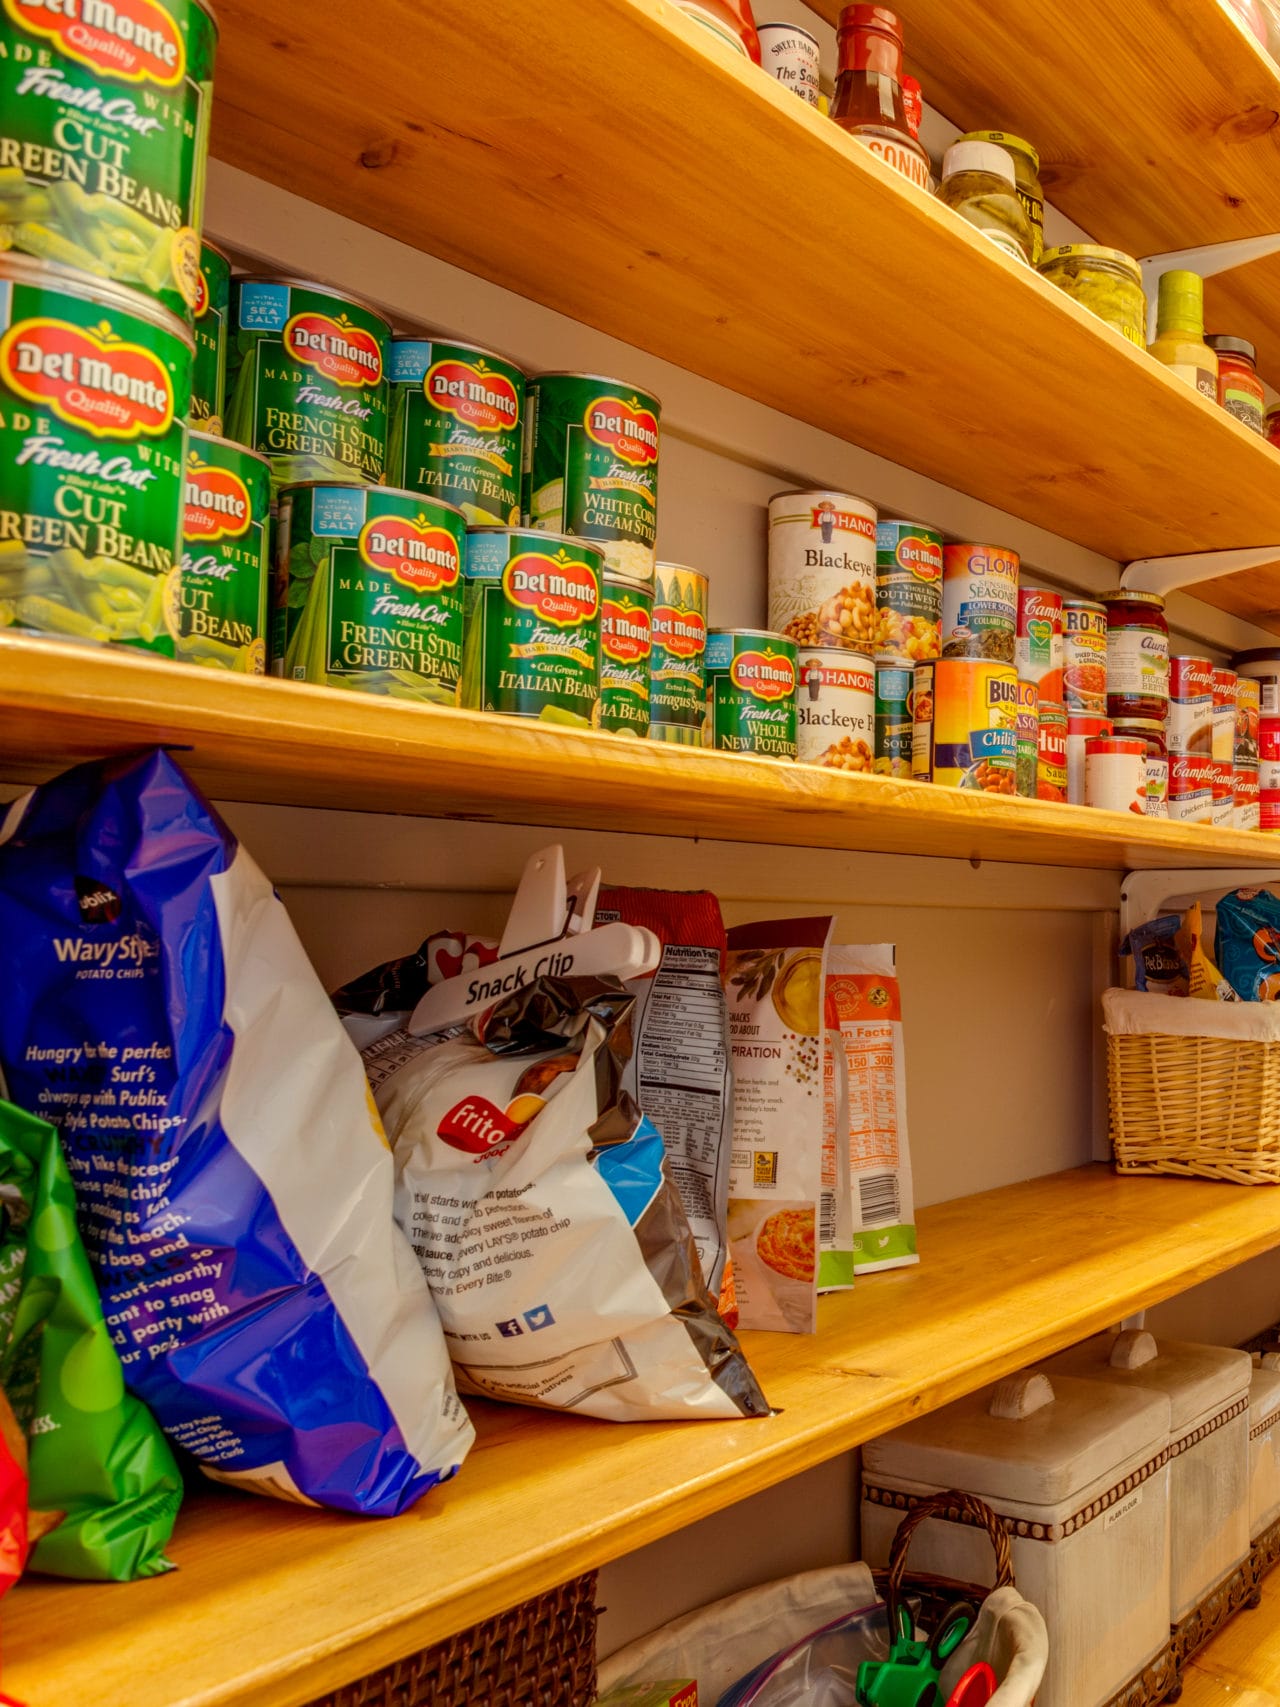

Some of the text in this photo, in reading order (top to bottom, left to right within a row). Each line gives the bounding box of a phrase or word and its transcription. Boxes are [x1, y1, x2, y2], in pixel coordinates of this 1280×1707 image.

[67, 25, 136, 68] Quality
[771, 40, 797, 56] SWEET
[776, 67, 797, 80] The
[53, 118, 130, 169] CUT
[97, 162, 182, 229] BEANS
[246, 315, 281, 324] SALT
[250, 306, 277, 315] SEA
[294, 328, 378, 372] Del Monte
[323, 357, 359, 377] Quality
[394, 368, 423, 376] SALT
[16, 343, 167, 412] Del Monte
[265, 369, 314, 385] MADE
[65, 389, 131, 423] Quality
[434, 376, 516, 417] Del Monte
[461, 402, 497, 422] Quality
[266, 408, 345, 441] FRENCH
[594, 412, 622, 433] Del
[269, 429, 382, 476] GREEN BEANS
[617, 439, 646, 457] Quality
[418, 467, 516, 507] ITALIAN BEANS
[54, 485, 127, 528] CUT
[583, 492, 632, 515] WHITE
[319, 521, 357, 530] SALT
[324, 512, 353, 521] SEA
[583, 508, 632, 532] CREAM
[99, 525, 172, 574] BEANS
[371, 533, 457, 571] Del Monte
[474, 555, 498, 563] SEA
[902, 547, 916, 560] Del
[400, 561, 438, 581] Quality
[471, 563, 501, 572] SALT
[805, 549, 871, 578] Blackeye
[968, 555, 1019, 583] GLORY
[339, 579, 391, 594] MADE
[513, 570, 596, 604] Del Monte
[542, 598, 577, 616] Quality
[969, 601, 997, 611] LOWER
[190, 612, 252, 645] BEANS
[974, 617, 1000, 627] COLLARD
[1067, 612, 1089, 630] RO
[340, 621, 423, 652] FRENCH
[343, 643, 459, 682] GREEN BEANS
[738, 664, 792, 684] Del Monte
[498, 671, 597, 700] ITALIAN BEANS
[719, 696, 751, 705] MADE
[747, 720, 787, 739] WHOLE
[722, 735, 752, 750] NEW
[983, 732, 1011, 748] Chili
[1181, 804, 1204, 818] Chicken
[53, 937, 119, 968] Wavy
[665, 947, 702, 958] Nutrition
[76, 969, 144, 979] POTATO CHIPS
[466, 952, 574, 1005] Snack Clip
[740, 1025, 760, 1036] ABOUT
[26, 1045, 83, 1064] Hungry
[654, 1051, 690, 1061] Carbohydrate
[848, 1055, 893, 1067] 150 300
[110, 1066, 156, 1083] Surf's
[38, 1090, 78, 1108] always
[120, 1090, 168, 1106] Publix
[90, 1113, 131, 1130] Potato
[452, 1104, 505, 1145] Frito
[130, 1156, 179, 1177] ocean
[127, 1213, 192, 1245] beach.
[483, 1219, 513, 1233] sweet
[521, 1217, 571, 1242] potato chip
[109, 1233, 189, 1267] bag and
[190, 1249, 214, 1261] so
[425, 1250, 455, 1262] sauce.
[473, 1248, 535, 1271] and delicious.
[110, 1261, 224, 1304] surf-worthy
[456, 1278, 485, 1294] Every
[144, 1288, 216, 1313] to snag
[132, 1302, 231, 1343] party with
[480, 1332, 491, 1341] US
[215, 1438, 242, 1449] Chips
[220, 1447, 245, 1459] Curls
